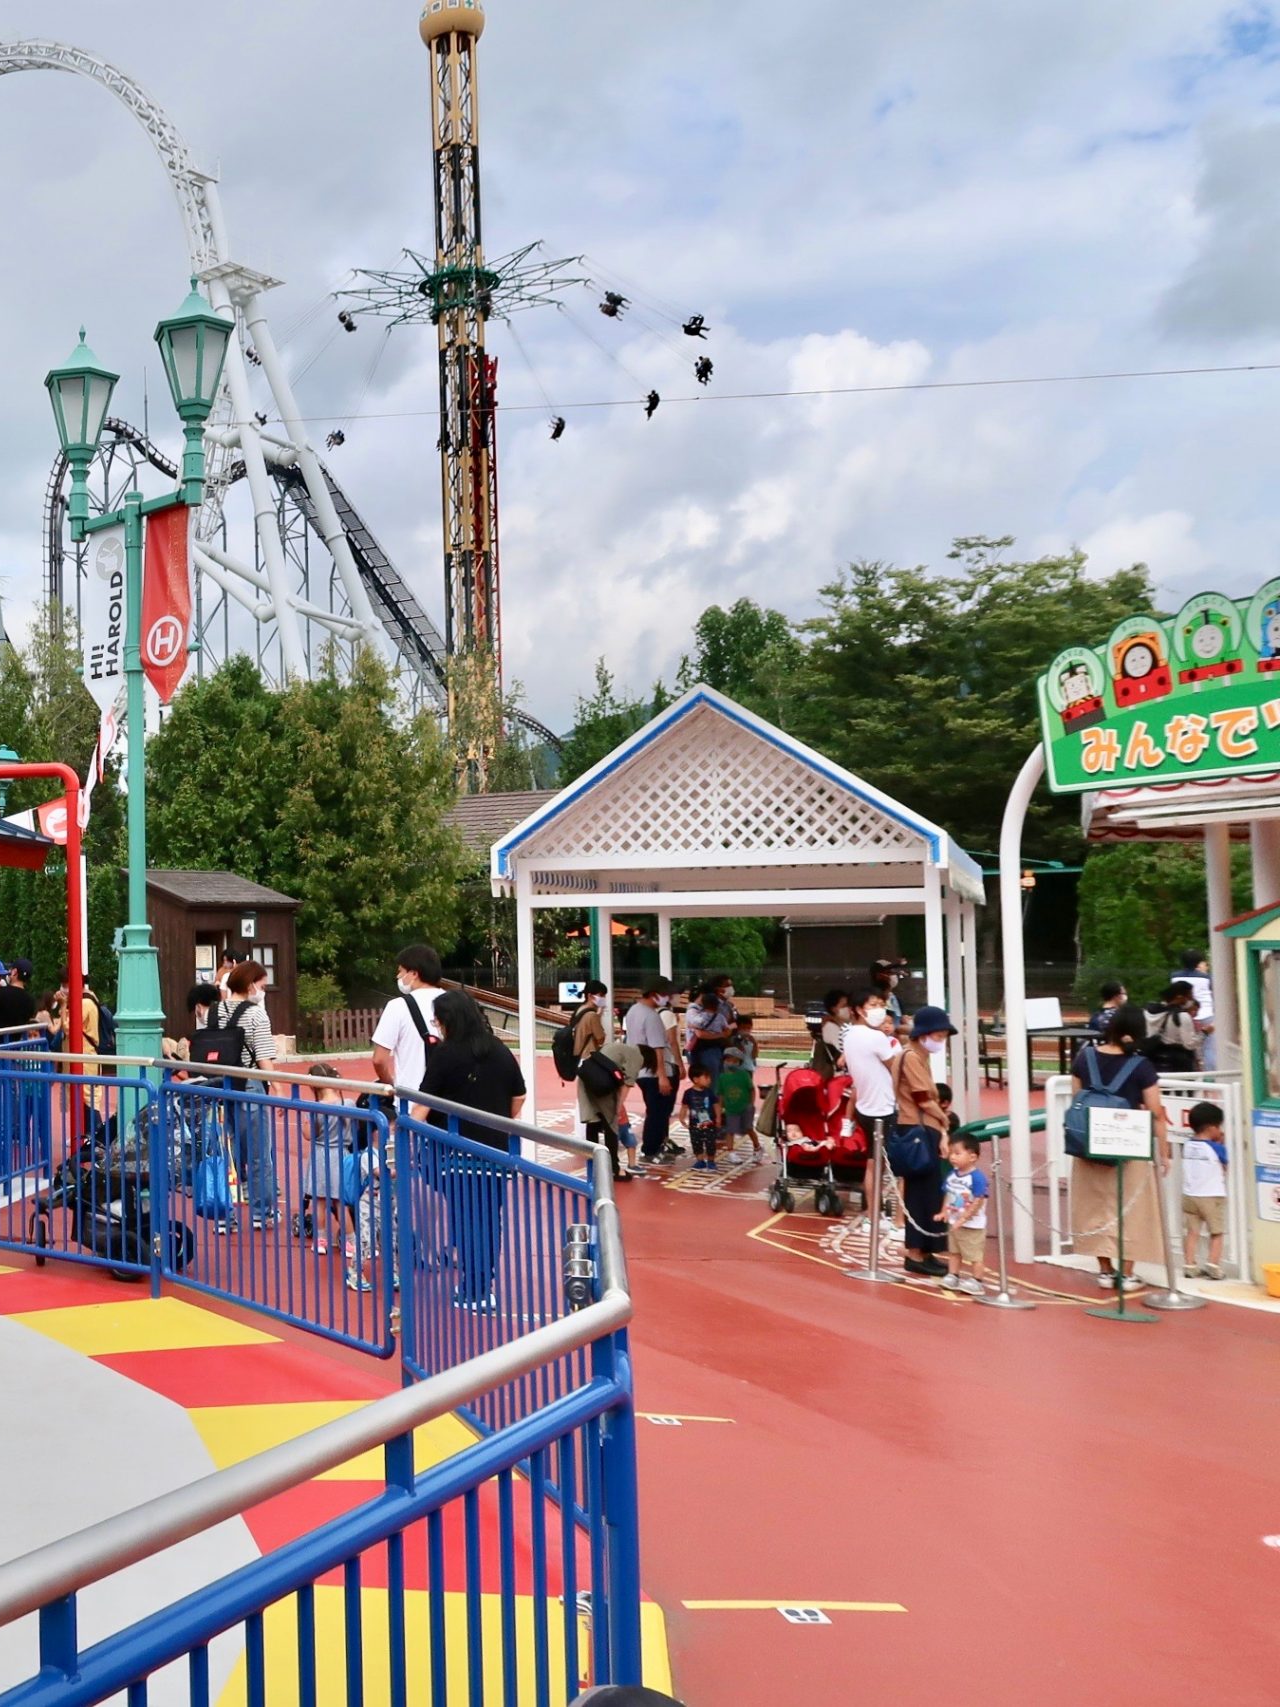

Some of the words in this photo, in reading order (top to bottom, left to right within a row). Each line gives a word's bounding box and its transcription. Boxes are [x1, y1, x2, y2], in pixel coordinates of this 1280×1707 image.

[106, 570, 123, 677] HAROLD
[1080, 698, 1280, 774] みんなで
